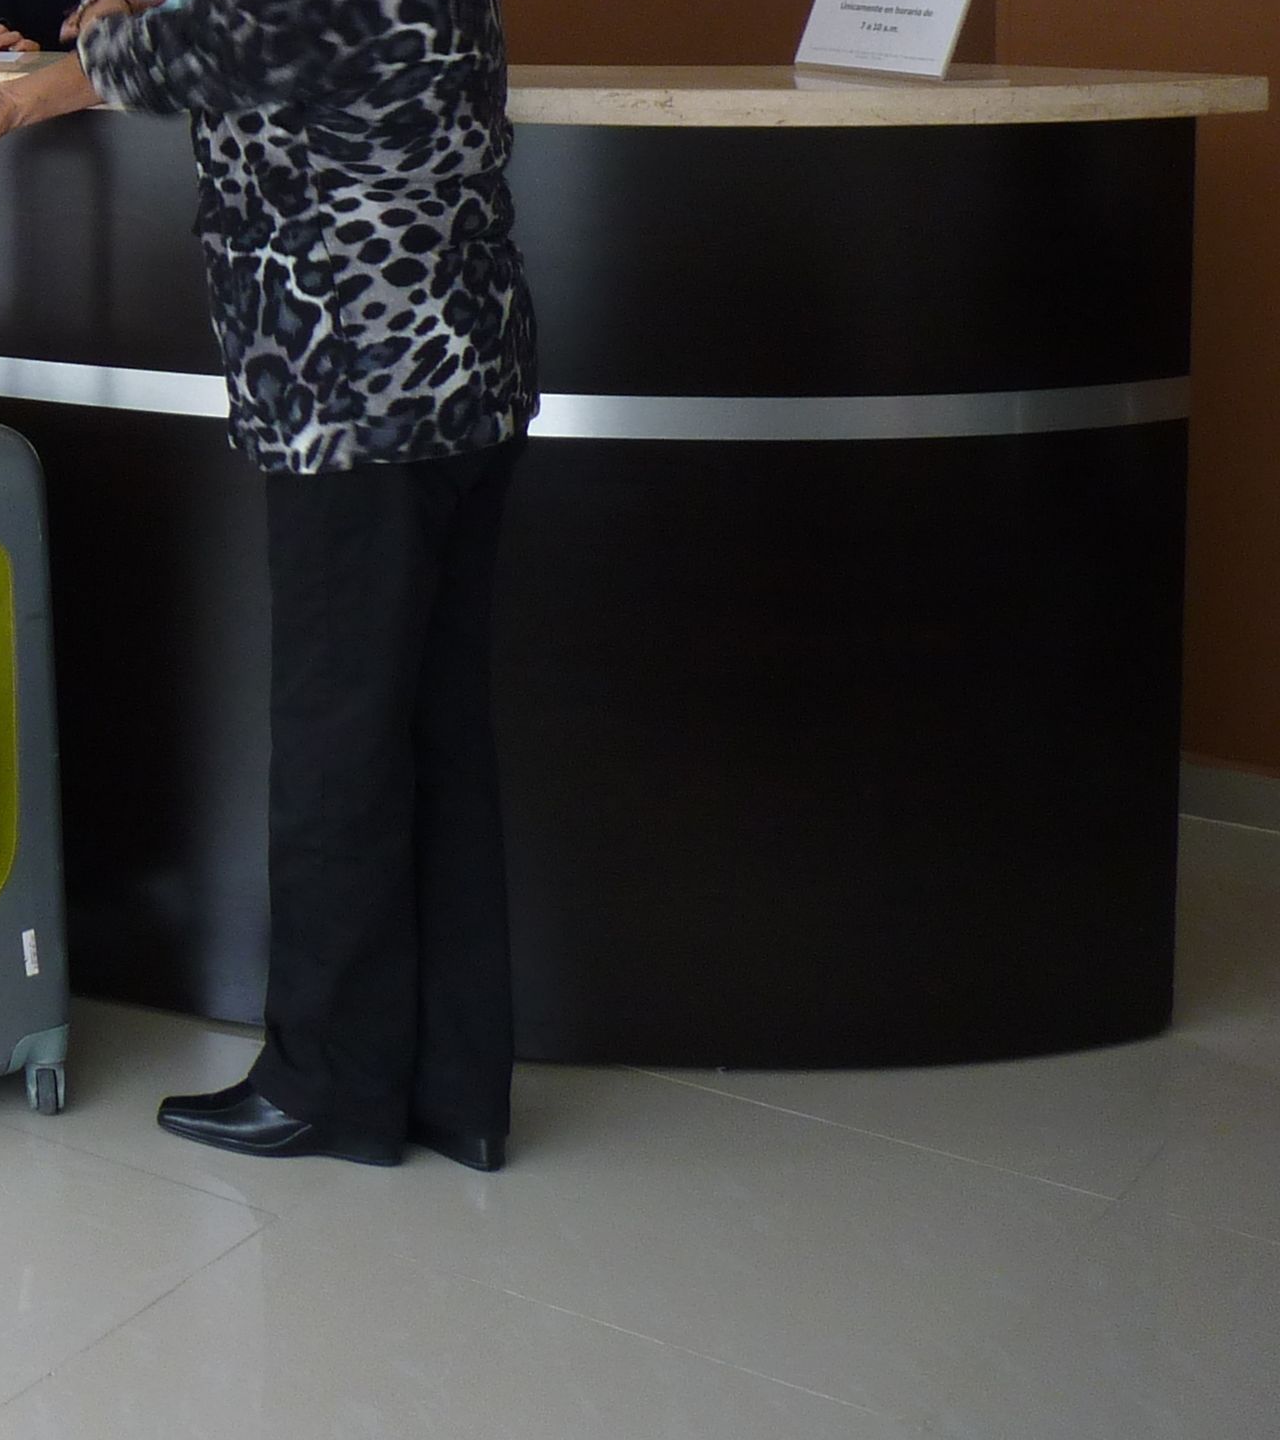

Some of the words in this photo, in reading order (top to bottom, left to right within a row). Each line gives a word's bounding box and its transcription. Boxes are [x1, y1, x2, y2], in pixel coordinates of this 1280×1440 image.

[895, 6, 922, 16] horario
[923, 9, 934, 17] de
[873, 22, 882, 31] 10
